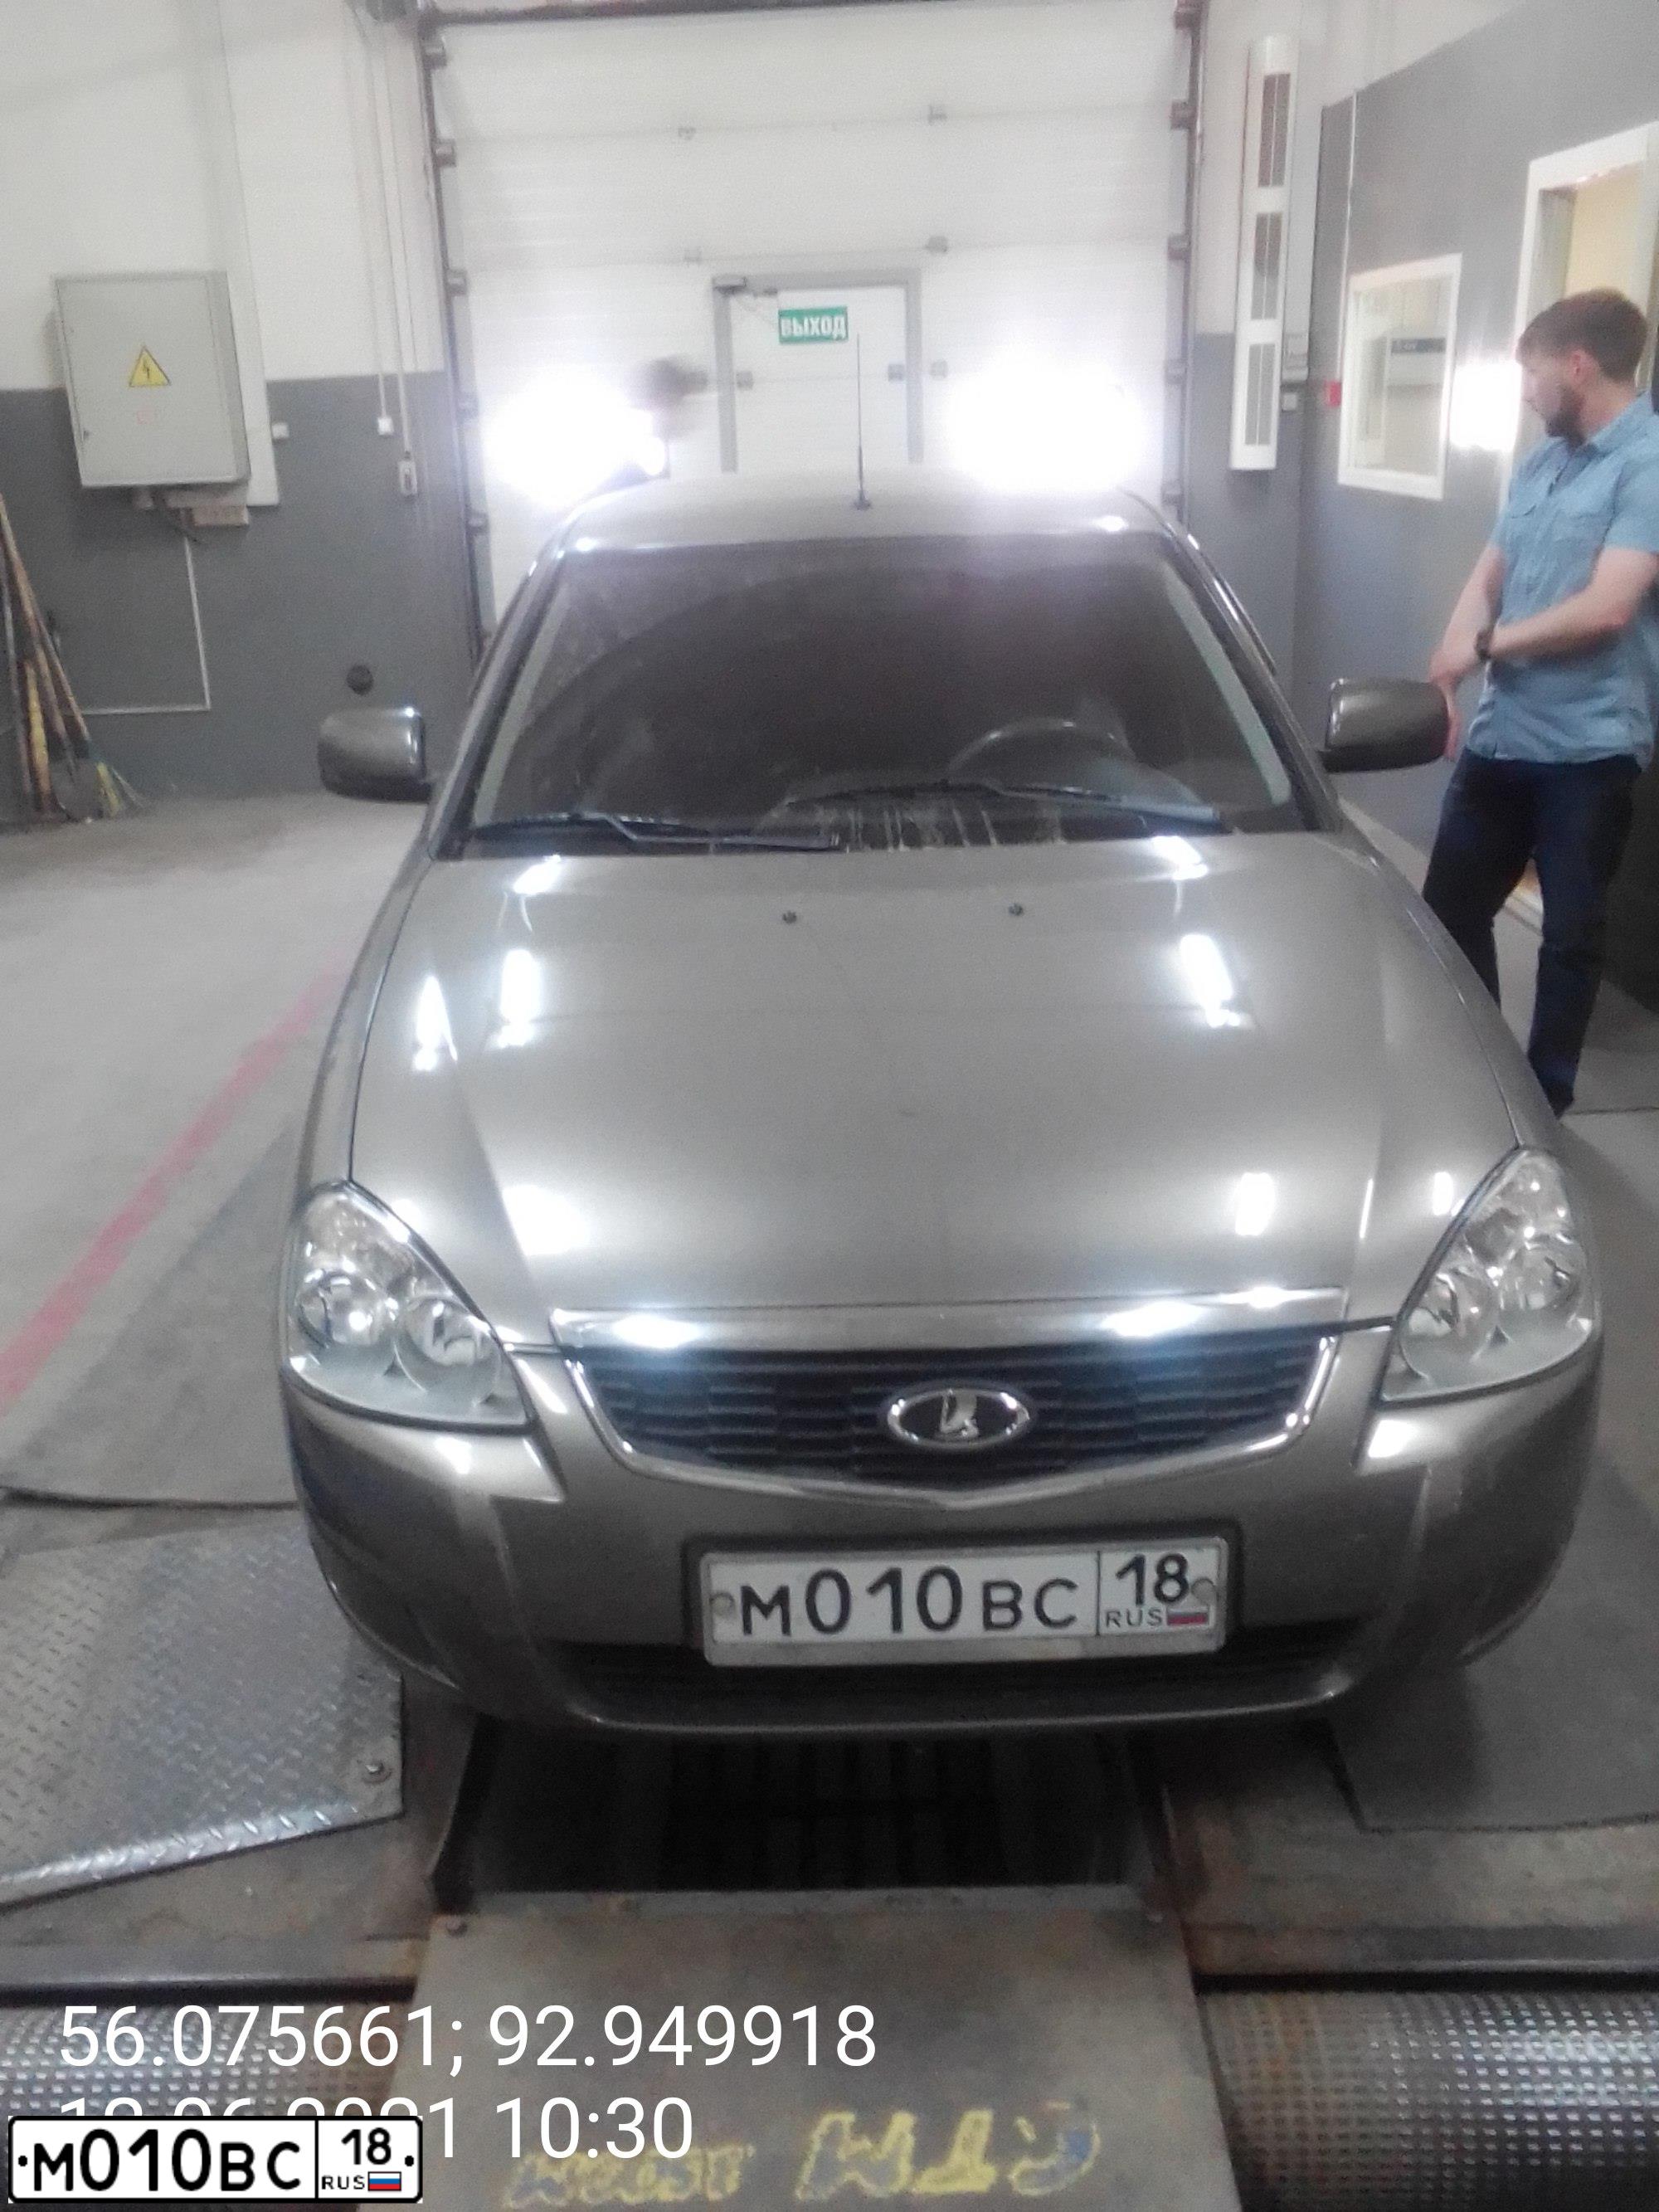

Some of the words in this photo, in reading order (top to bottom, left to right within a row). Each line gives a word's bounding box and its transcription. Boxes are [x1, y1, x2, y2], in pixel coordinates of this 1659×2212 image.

[781, 315, 846, 341] ВЫХОД
[1115, 1552, 1190, 1605] 18
[739, 1565, 1080, 1636] М010ВС
[1104, 1608, 1162, 1628] RUS
